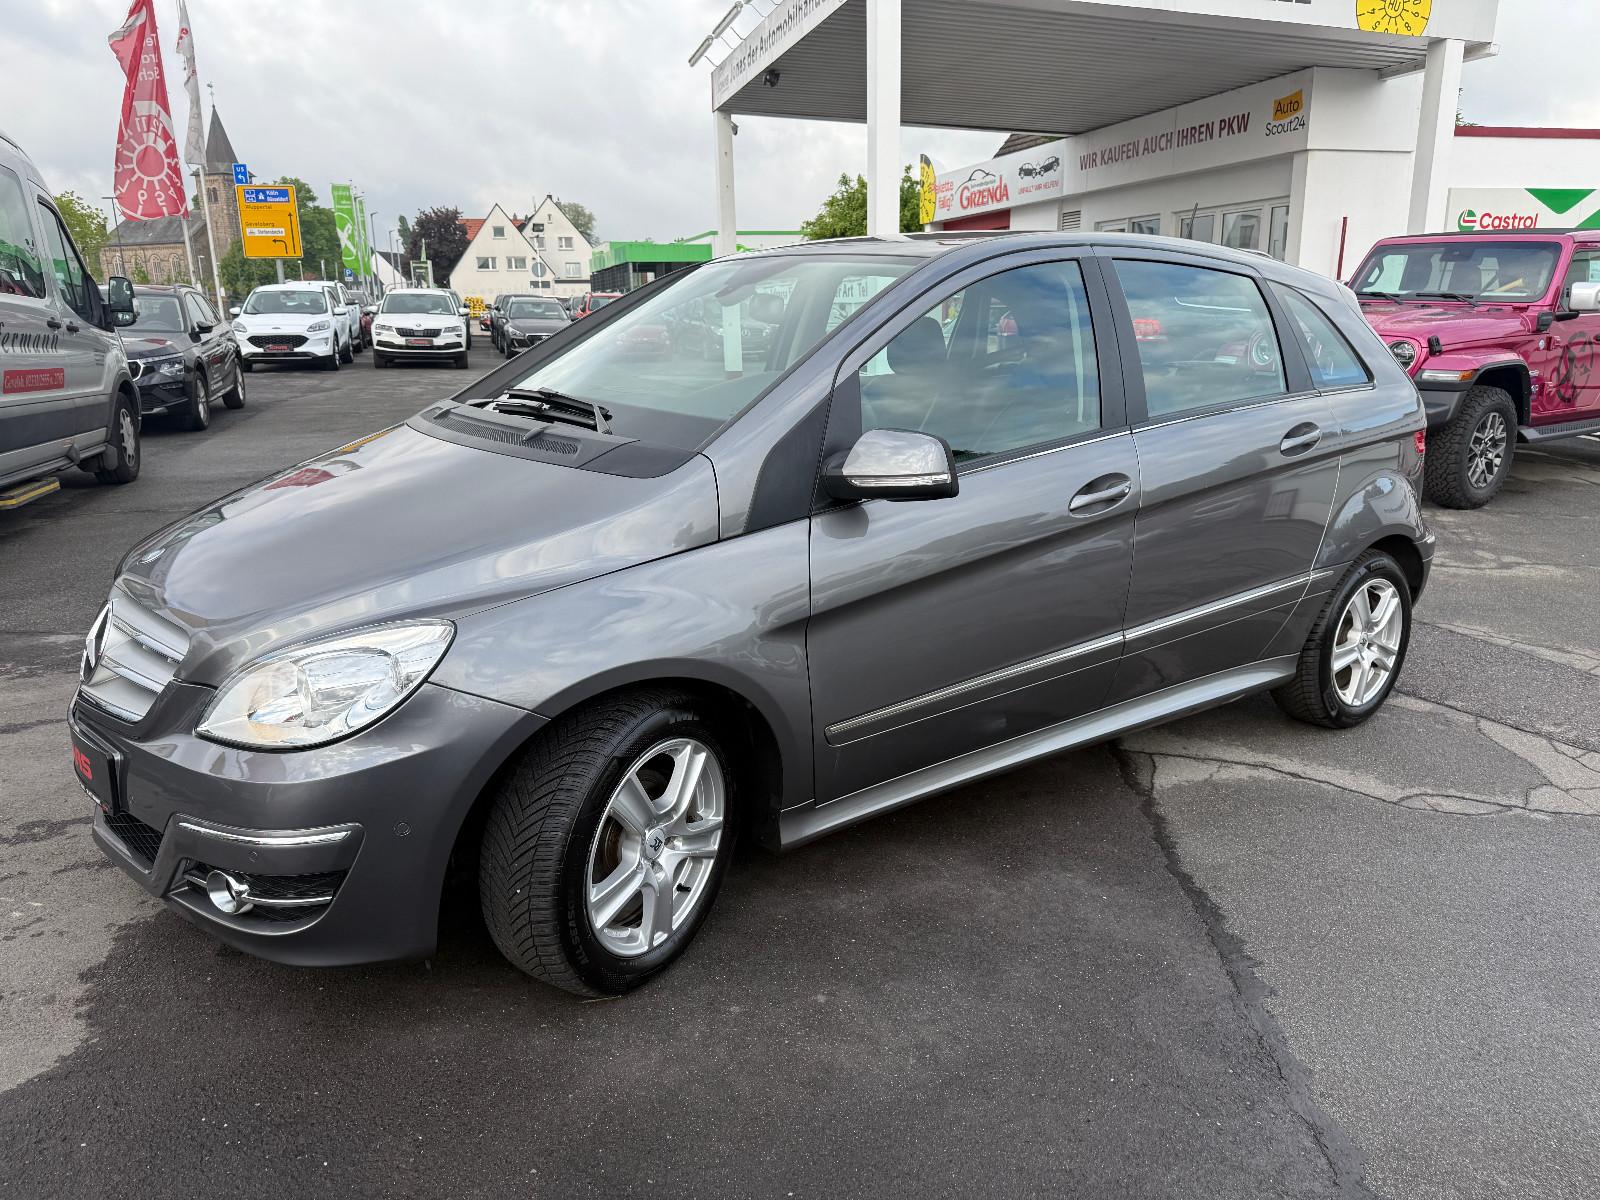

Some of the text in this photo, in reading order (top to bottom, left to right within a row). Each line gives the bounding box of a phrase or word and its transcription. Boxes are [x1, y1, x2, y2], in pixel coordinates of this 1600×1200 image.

[748, 44, 758, 67] der
[1274, 99, 1300, 116] Auto
[1265, 115, 1306, 137] Scout24
[1079, 112, 1251, 171] WIR KAUFEN AUCH IHREN PKW
[1479, 212, 1539, 230] Castrol
